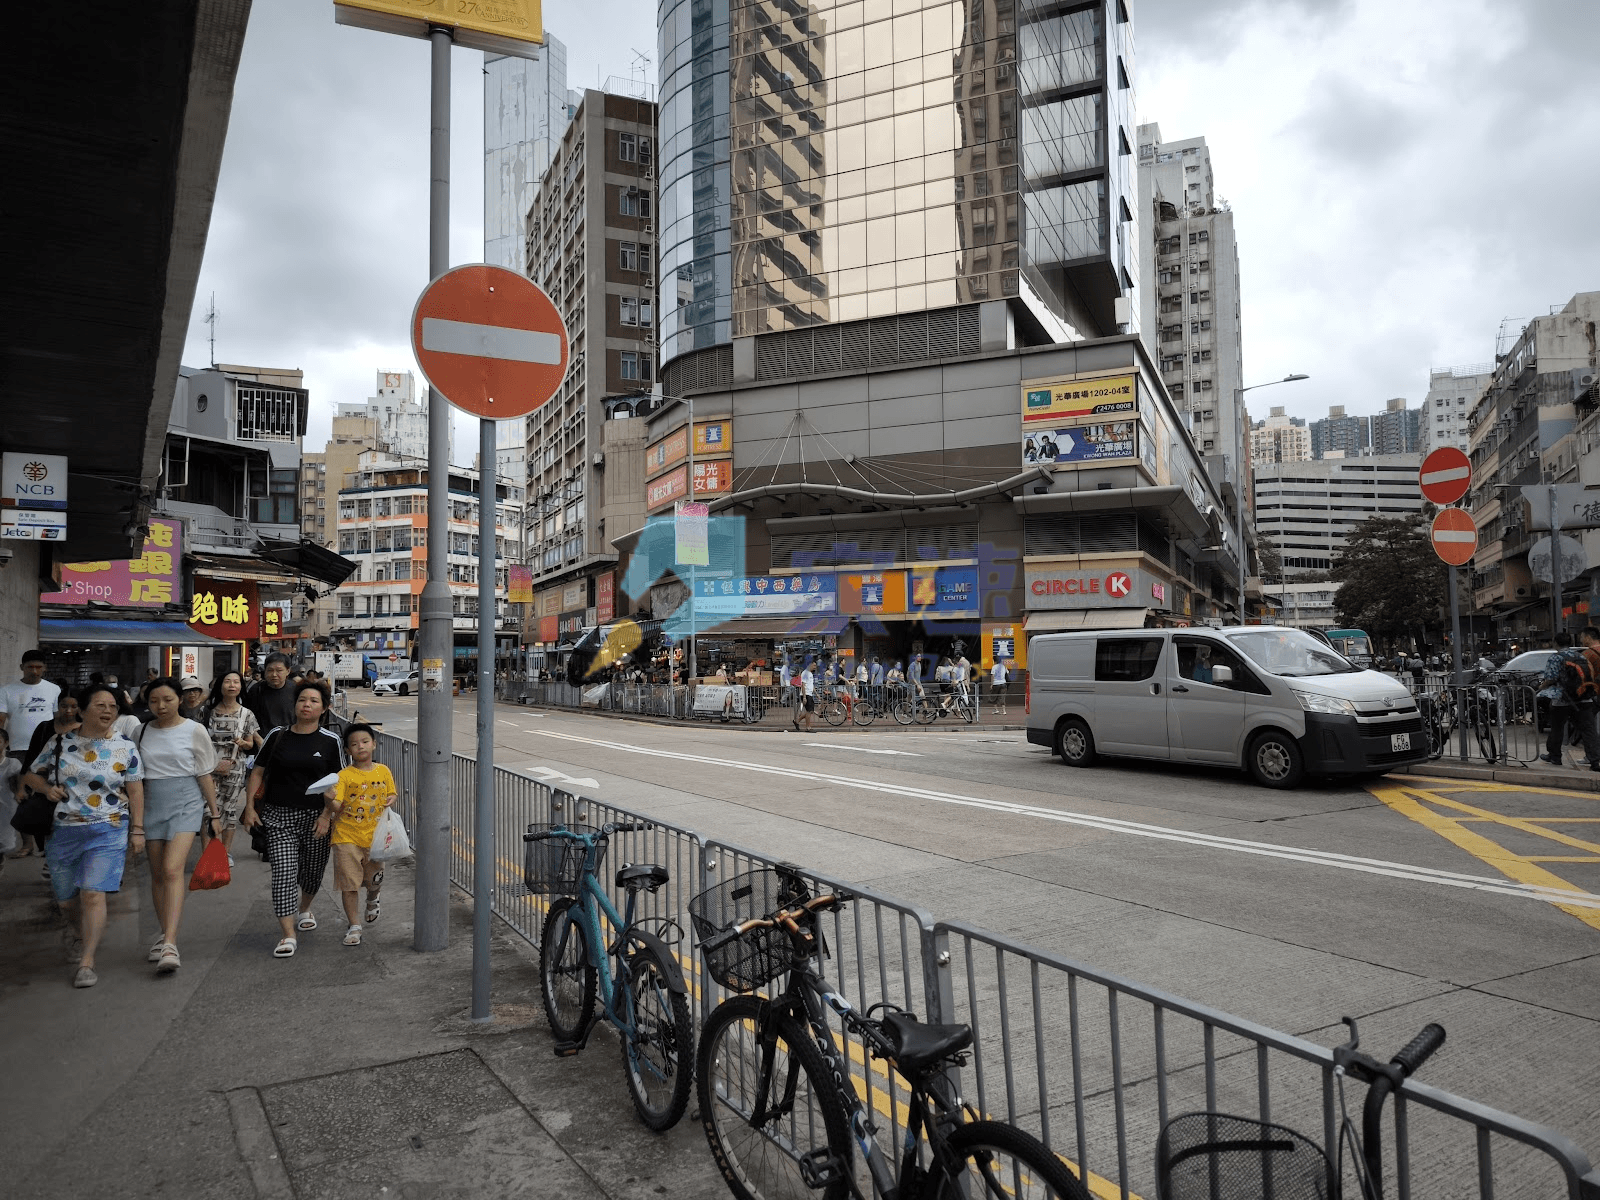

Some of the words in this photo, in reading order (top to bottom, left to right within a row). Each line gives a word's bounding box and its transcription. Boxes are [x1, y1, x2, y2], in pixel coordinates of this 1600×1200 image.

[457, 0, 477, 14] 27
[1055, 385, 1131, 401] 光華廣場1202-04室
[1100, 404, 1115, 412] 2476
[15, 483, 55, 496] NCB
[75, 581, 112, 599] Shop
[939, 582, 972, 593] GAME
[1031, 578, 1100, 595] CIRCLE
[1111, 576, 1129, 596] K
